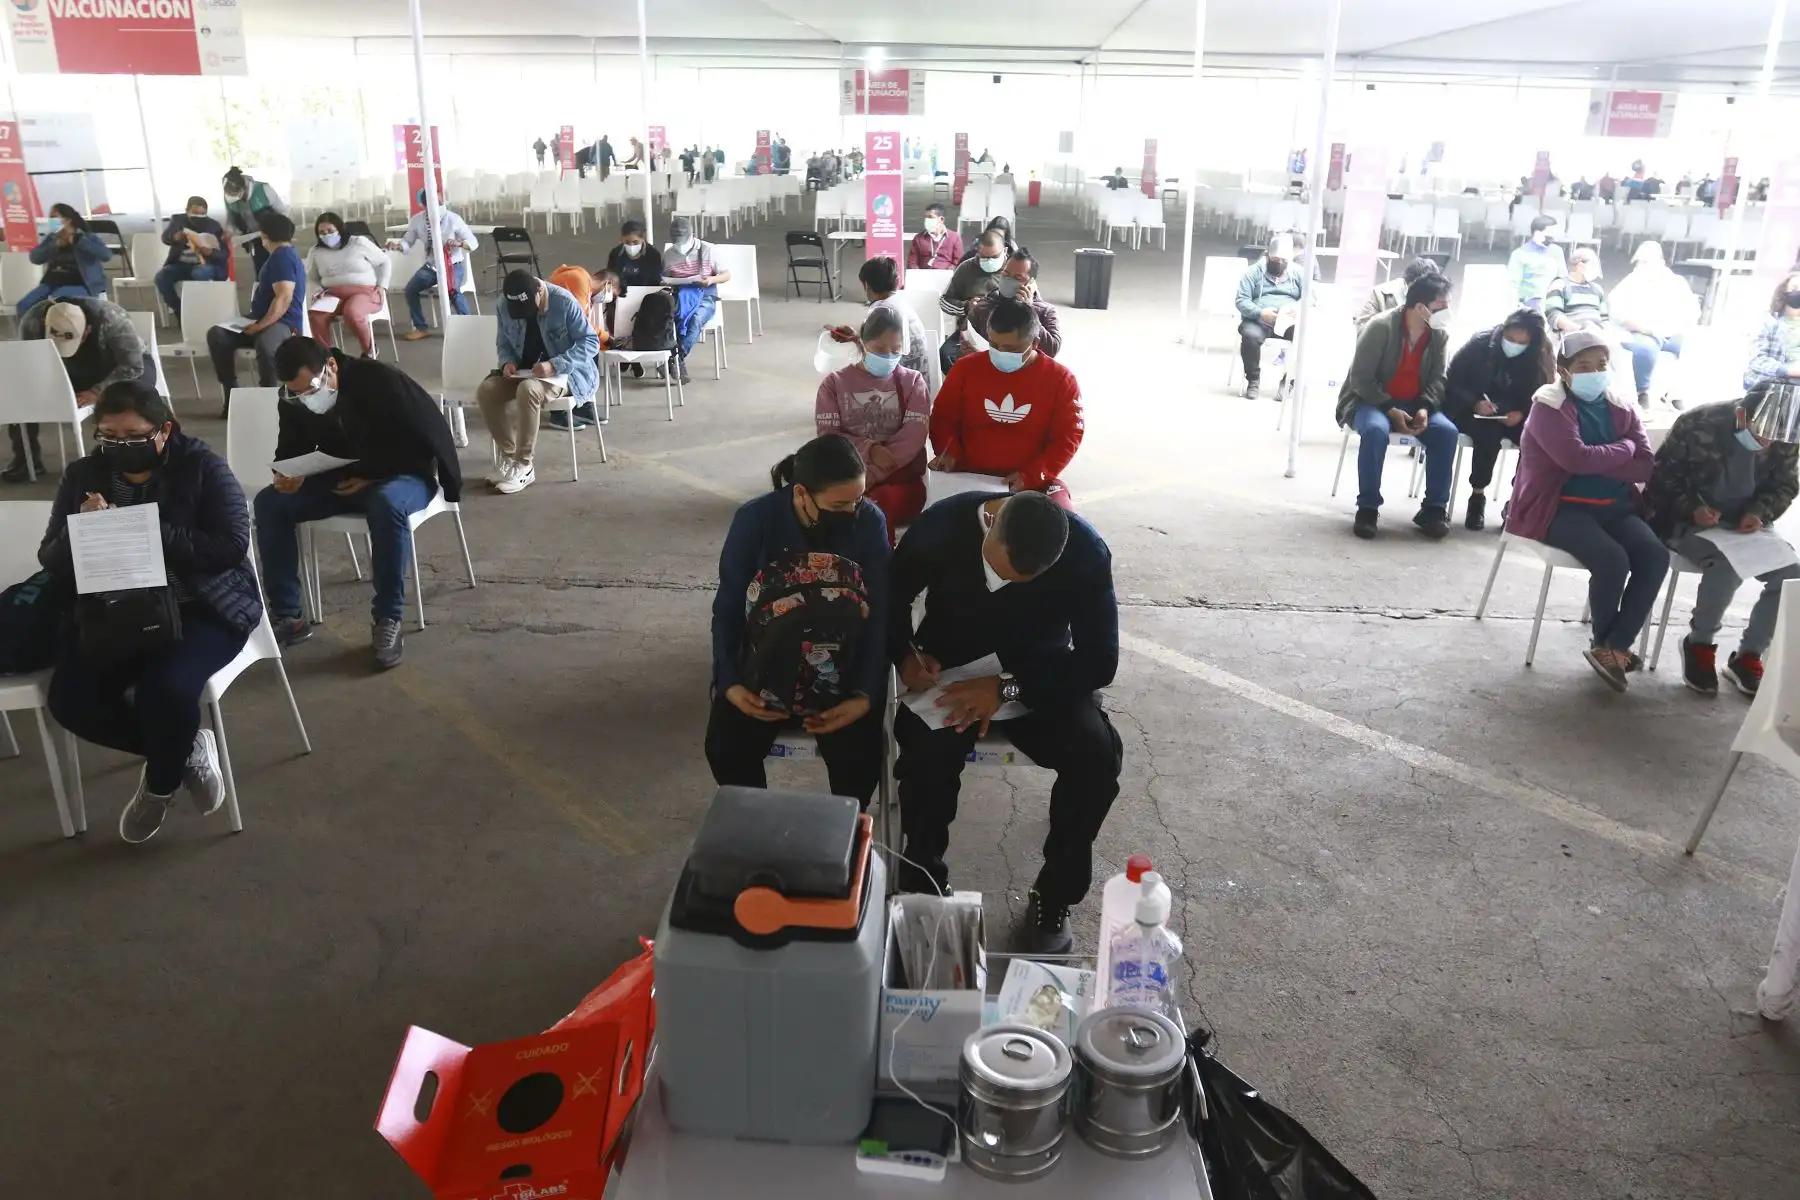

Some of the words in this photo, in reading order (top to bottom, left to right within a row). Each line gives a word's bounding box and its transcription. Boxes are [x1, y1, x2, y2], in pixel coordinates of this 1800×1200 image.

[412, 130, 422, 143] 2
[872, 136, 893, 150] 25
[515, 1042, 569, 1060] CUIDADO
[485, 1140, 520, 1153] RIESGO
